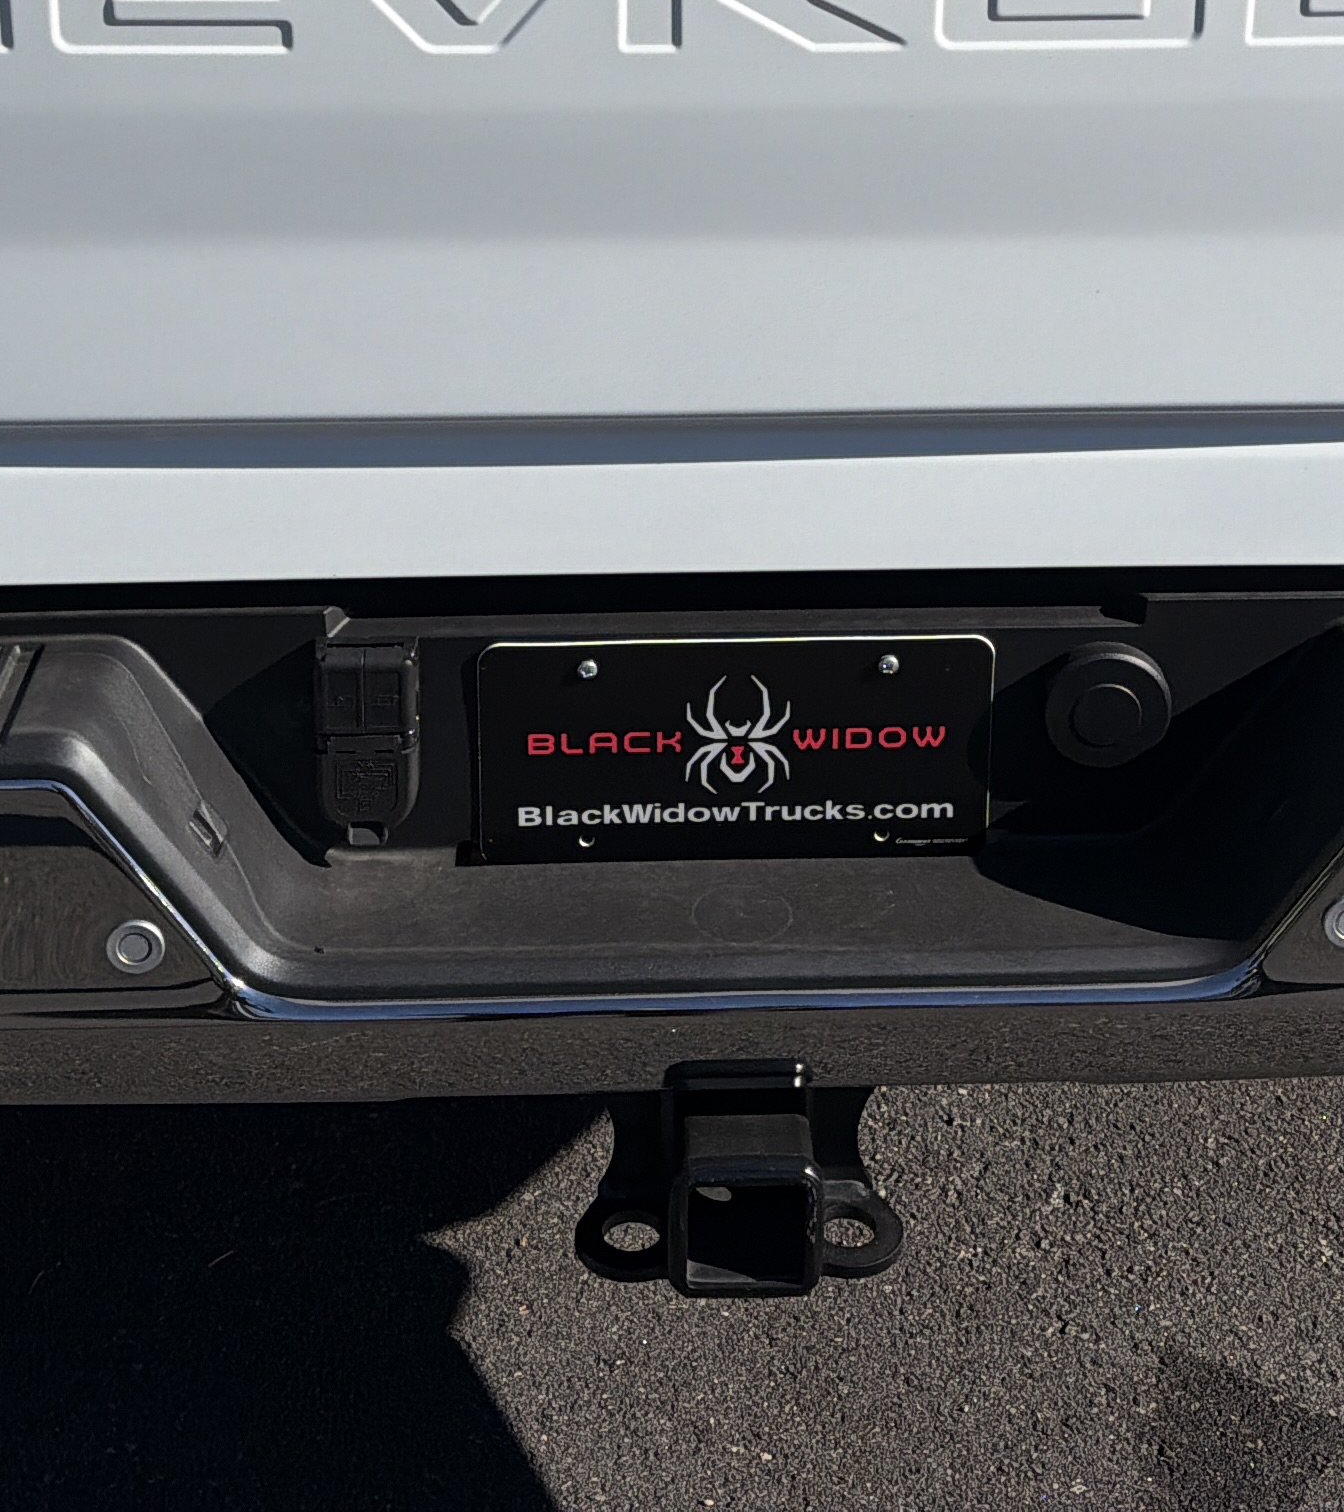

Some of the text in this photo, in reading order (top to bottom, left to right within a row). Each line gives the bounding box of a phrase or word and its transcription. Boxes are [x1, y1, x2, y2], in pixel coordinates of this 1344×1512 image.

[527, 726, 947, 756] BLACK WIDOW
[518, 800, 954, 827] BlackWidowTrucks.com
